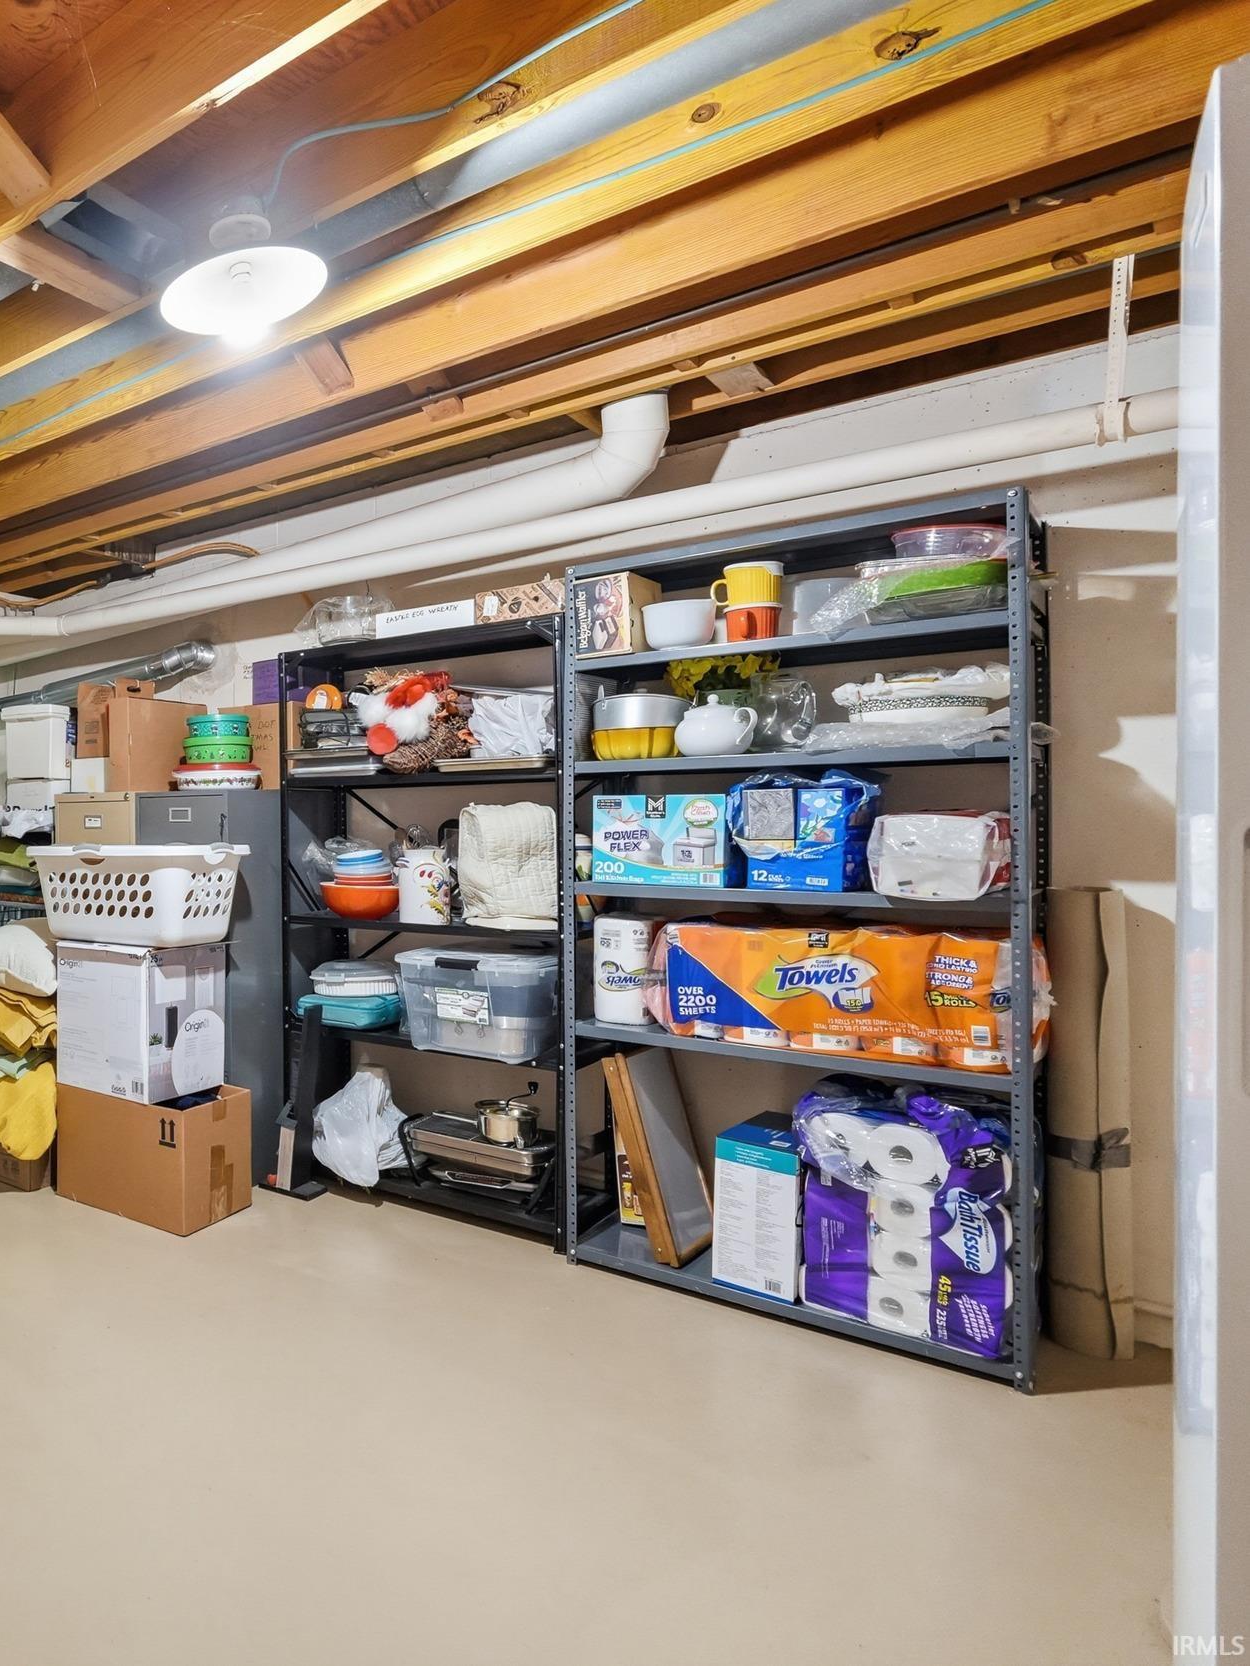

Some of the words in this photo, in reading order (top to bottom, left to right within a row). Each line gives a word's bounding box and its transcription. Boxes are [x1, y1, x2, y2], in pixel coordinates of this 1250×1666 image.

[604, 829, 650, 841] POWER
[610, 841, 643, 853] FLEX
[595, 861, 625, 873] 200
[751, 869, 768, 881] 12
[934, 955, 967, 968] THICK
[605, 975, 641, 986] owels
[774, 963, 859, 991] Towels
[677, 986, 704, 995] OVER
[678, 995, 717, 1006] 2200
[679, 1006, 716, 1015] SHEETS
[939, 1275, 952, 1292] 45
[936, 1308, 947, 1326] 235
